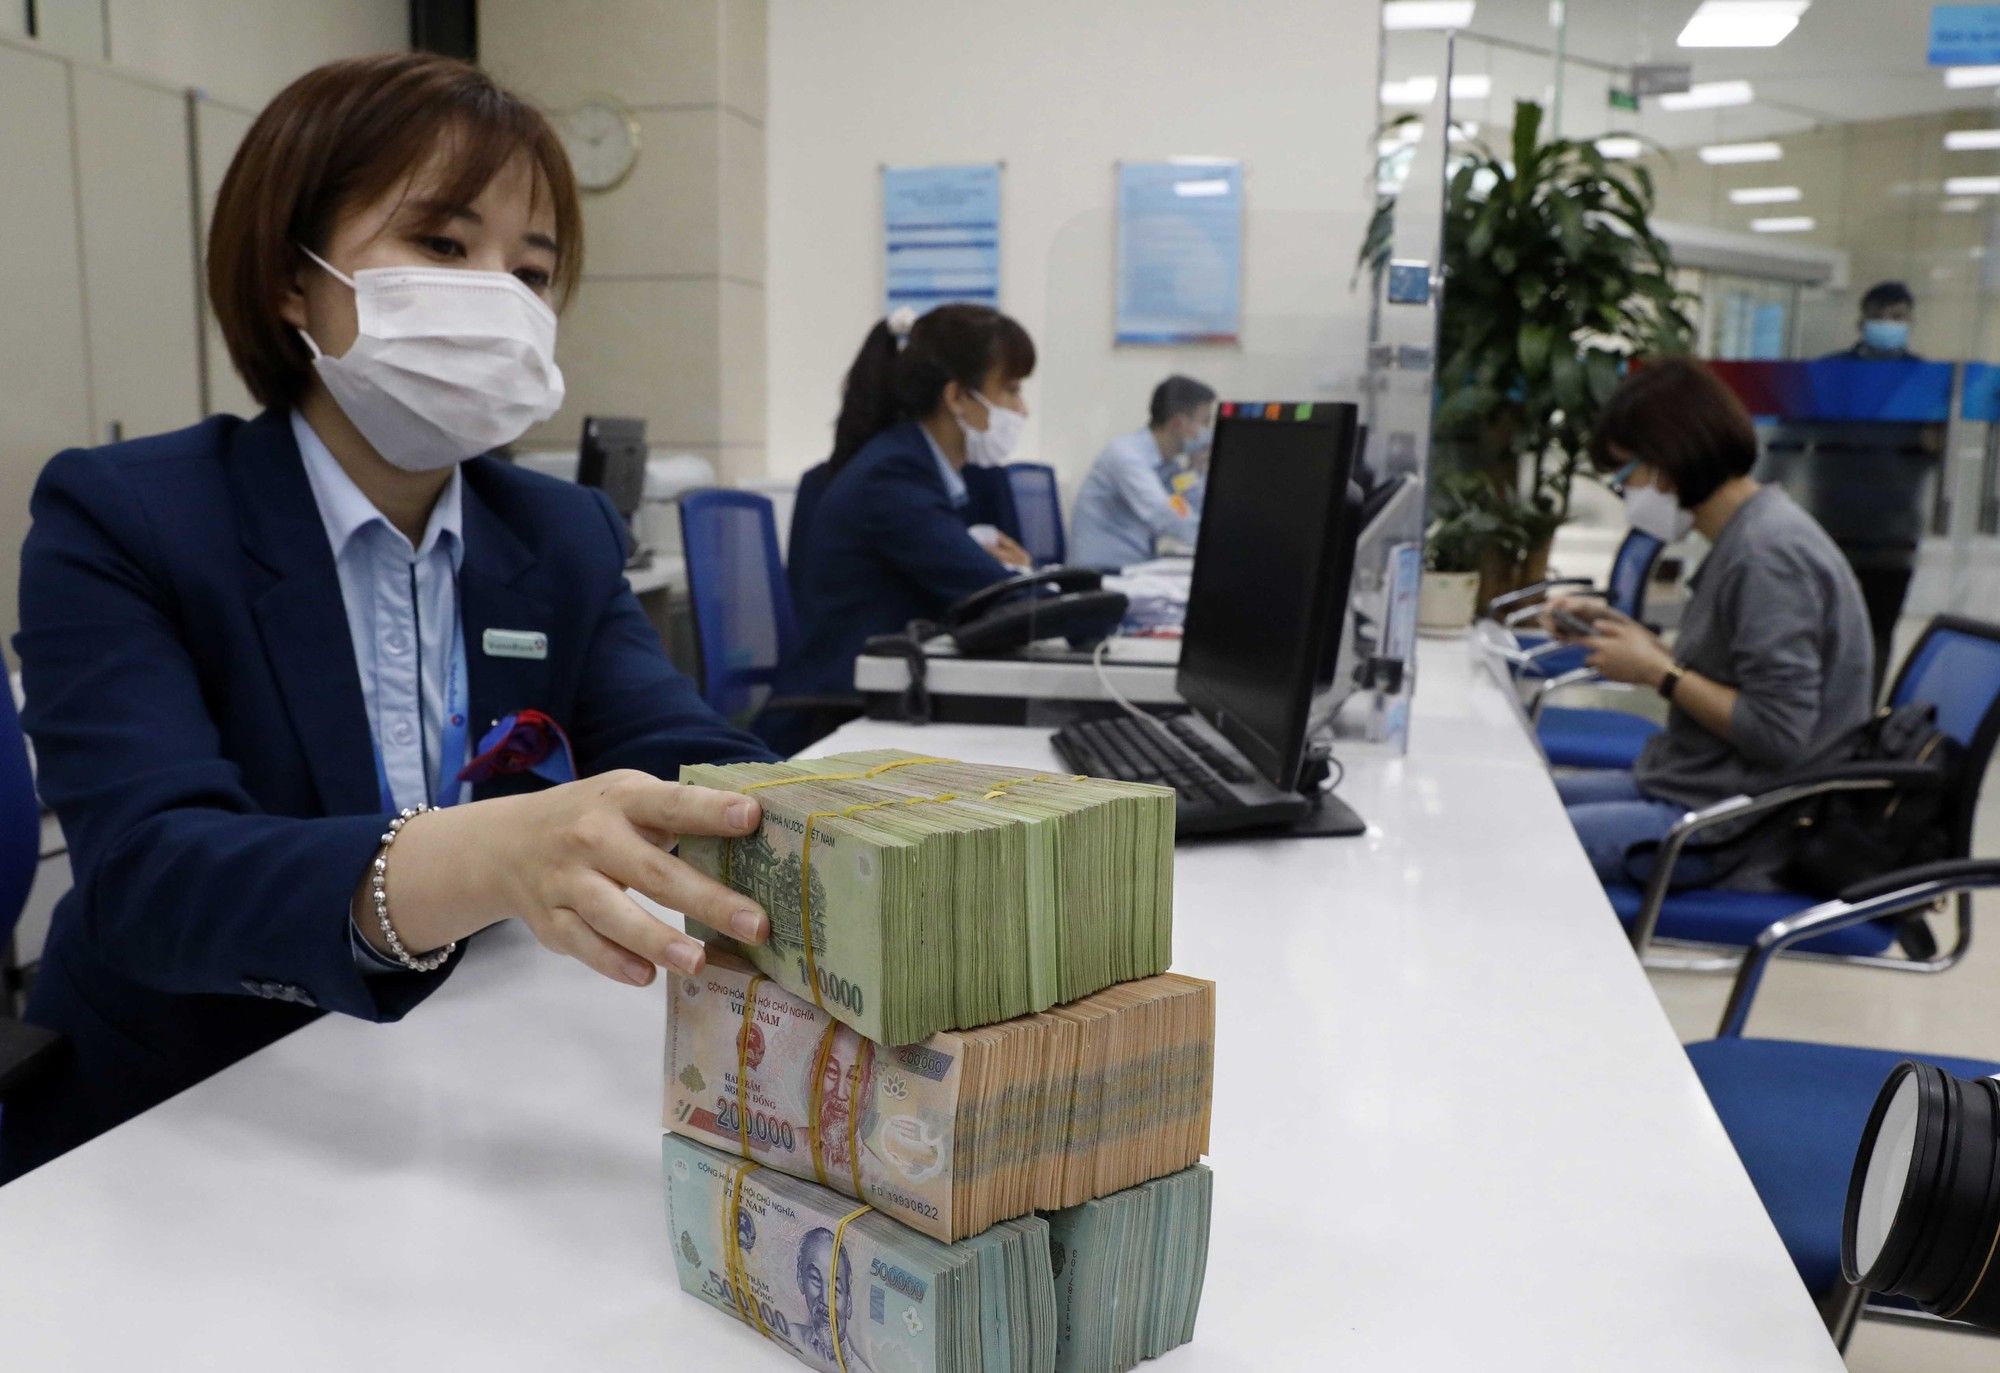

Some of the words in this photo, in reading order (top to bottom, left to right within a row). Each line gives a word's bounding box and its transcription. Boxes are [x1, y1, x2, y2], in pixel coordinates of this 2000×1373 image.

[821, 833, 836, 848] NAM
[757, 1010, 781, 1027] NAM
[745, 1198, 766, 1216] NAM
[888, 1192, 938, 1220] 19930622
